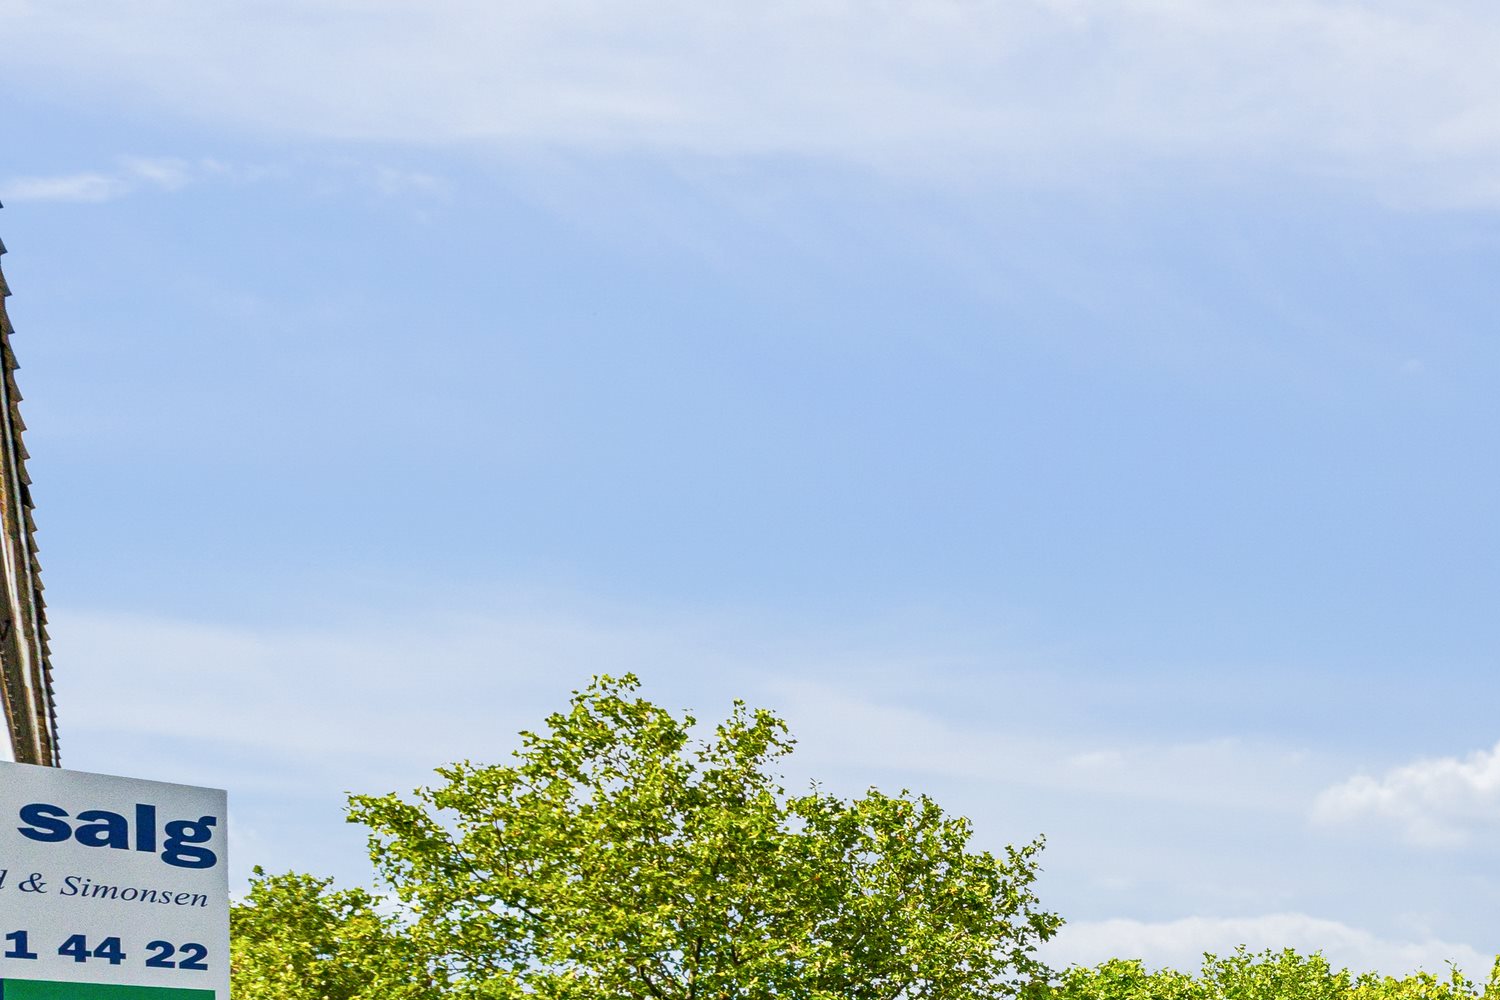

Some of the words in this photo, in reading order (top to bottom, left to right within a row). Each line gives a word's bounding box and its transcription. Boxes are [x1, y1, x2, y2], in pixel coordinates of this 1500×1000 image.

[17, 803, 218, 869] salg
[18, 872, 48, 894] &
[59, 875, 209, 908] Simonsen
[57, 934, 127, 965] 44
[145, 940, 209, 971] 22
